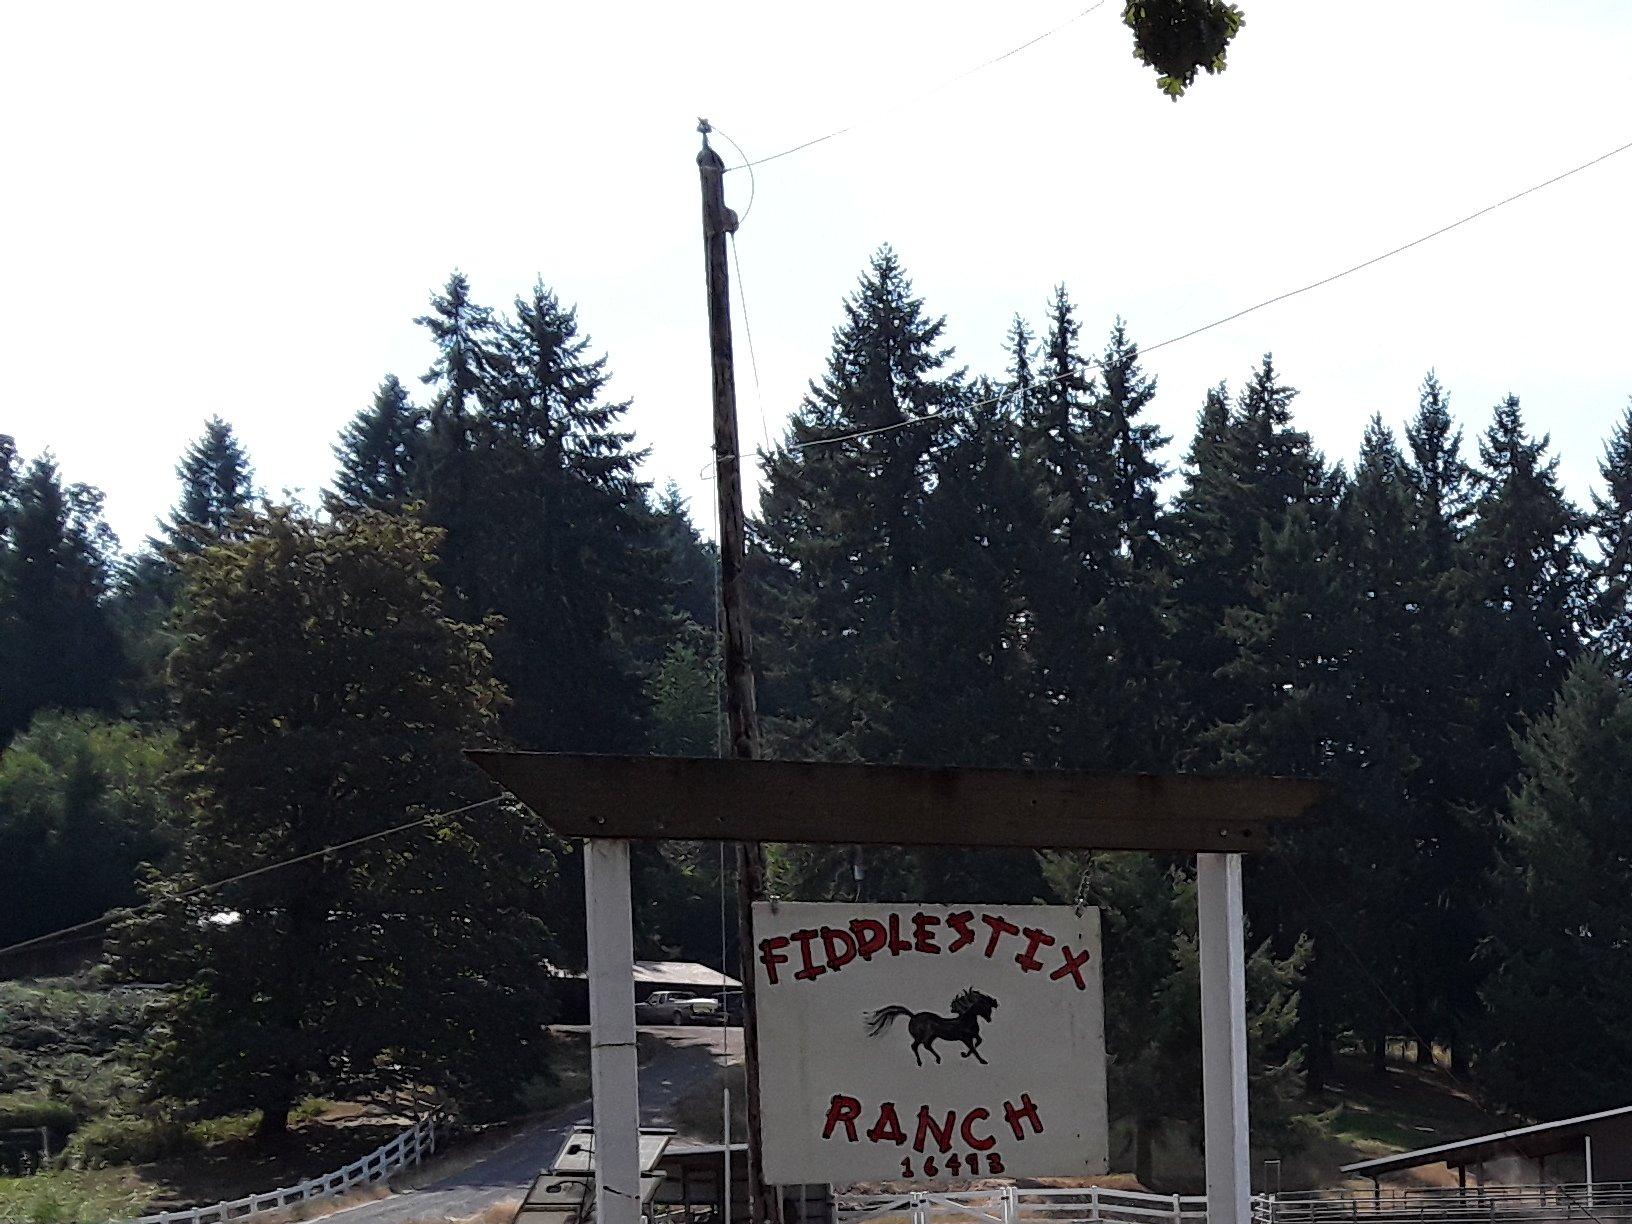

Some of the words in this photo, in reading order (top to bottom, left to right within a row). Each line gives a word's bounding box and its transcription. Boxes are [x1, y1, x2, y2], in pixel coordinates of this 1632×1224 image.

[759, 911, 1090, 991] FIDDLESTIX
[821, 1093, 1044, 1153] RANCH
[901, 1152, 1005, 1178] 16493
